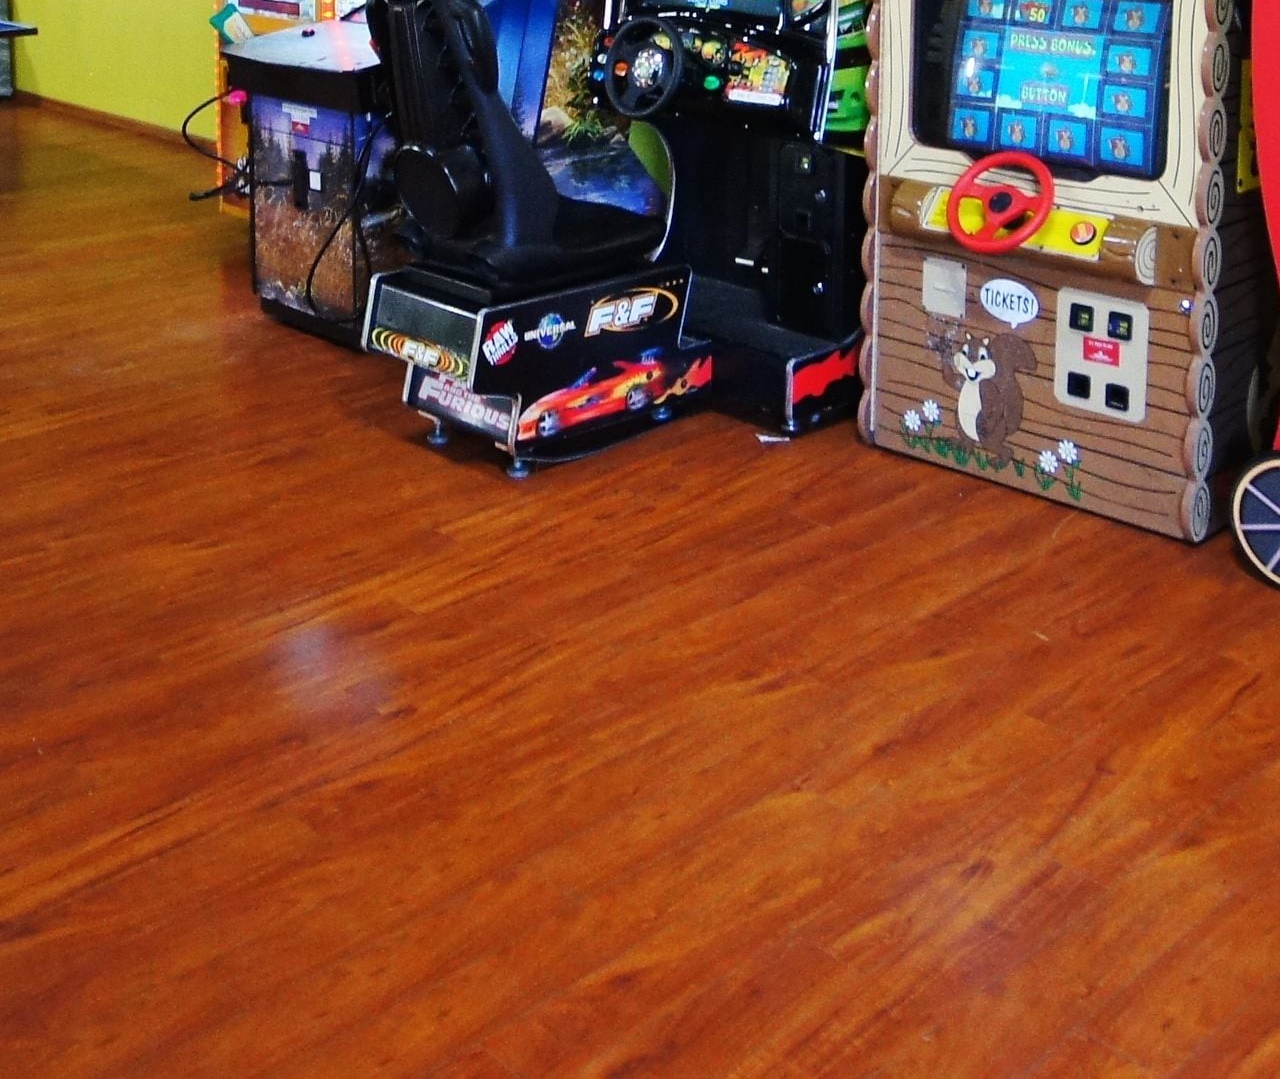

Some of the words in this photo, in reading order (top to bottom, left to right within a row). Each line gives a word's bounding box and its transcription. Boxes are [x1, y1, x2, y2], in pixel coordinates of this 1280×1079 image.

[1029, 8, 1045, 22] 50
[1010, 34, 1047, 51] PRESS
[1021, 86, 1066, 103] BUTTON
[586, 294, 658, 335] F&F
[984, 288, 1034, 316] TICKETS!
[482, 319, 516, 362] RAW
[524, 320, 576, 342] UNIVERSAL
[401, 339, 441, 367] F&F
[487, 332, 518, 366] THRILLS
[418, 376, 511, 430] FURIOUS
